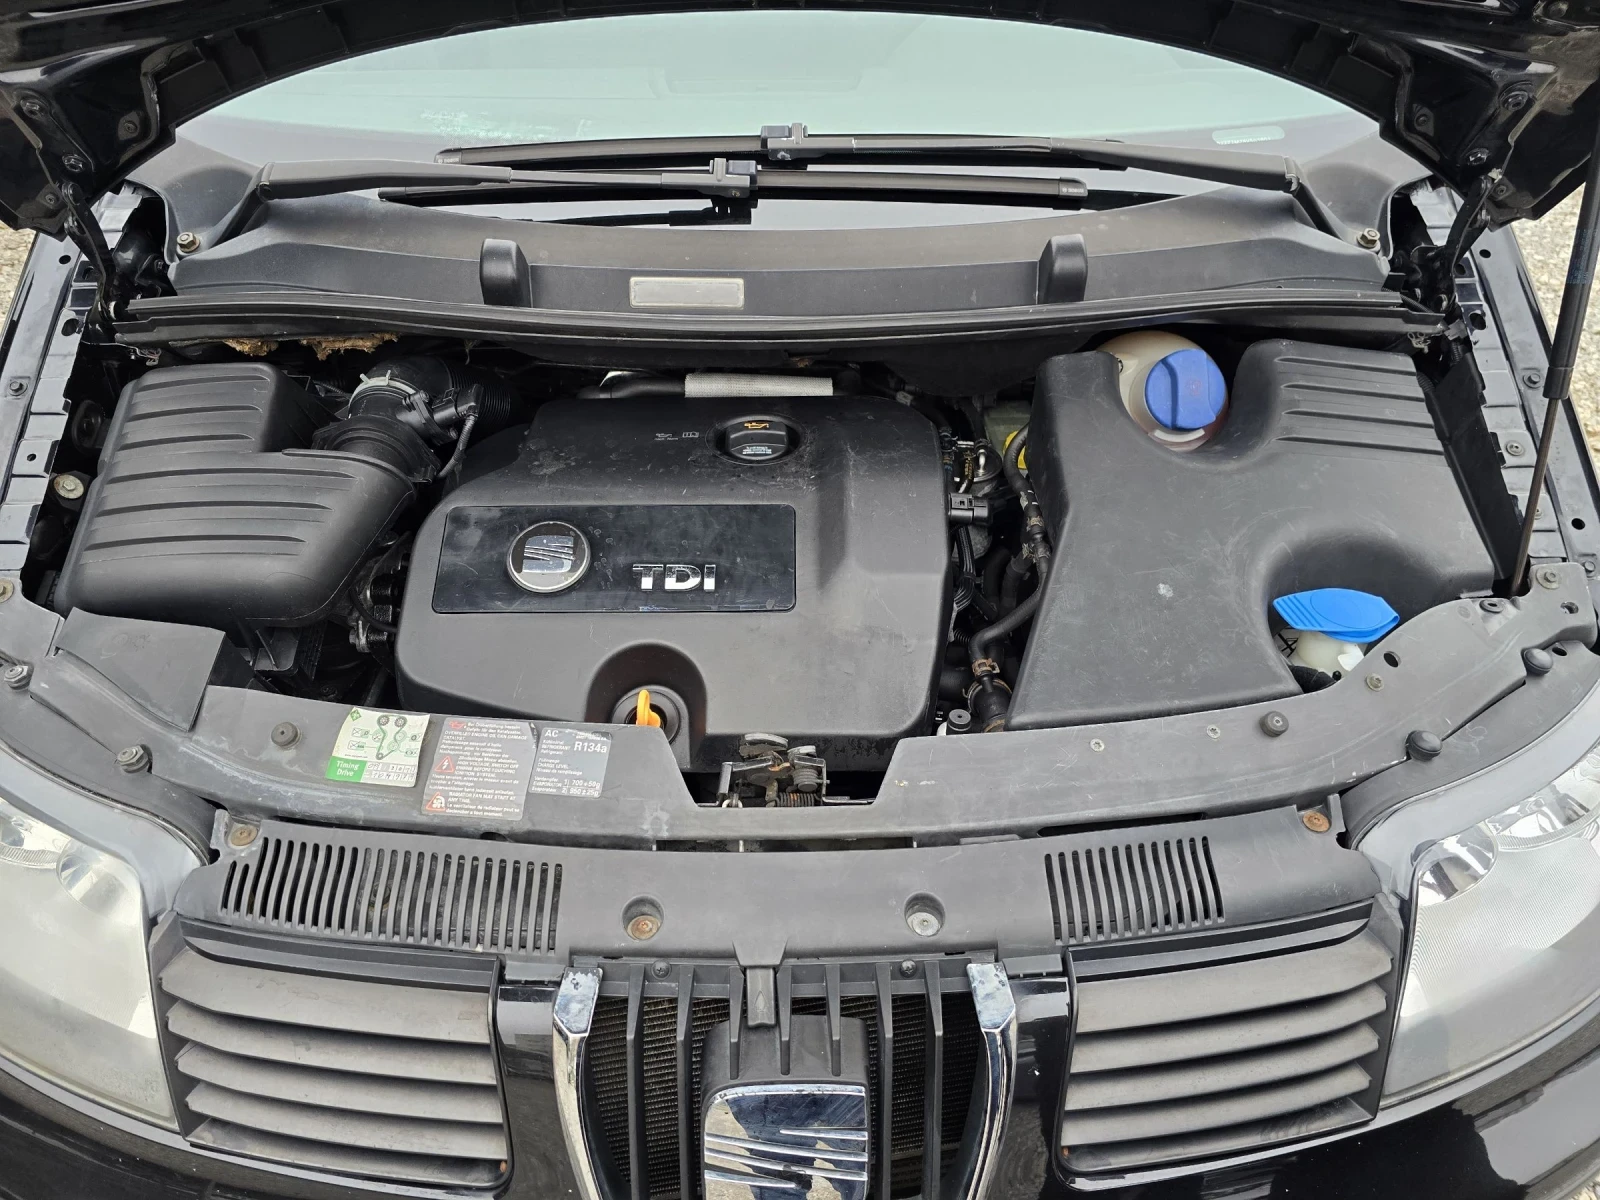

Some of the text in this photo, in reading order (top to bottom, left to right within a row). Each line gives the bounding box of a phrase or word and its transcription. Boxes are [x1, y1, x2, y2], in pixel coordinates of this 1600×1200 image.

[632, 563, 717, 592] TDI
[574, 742, 608, 753] R134a
[336, 761, 360, 770] Timing
[337, 768, 354, 776] Drive
